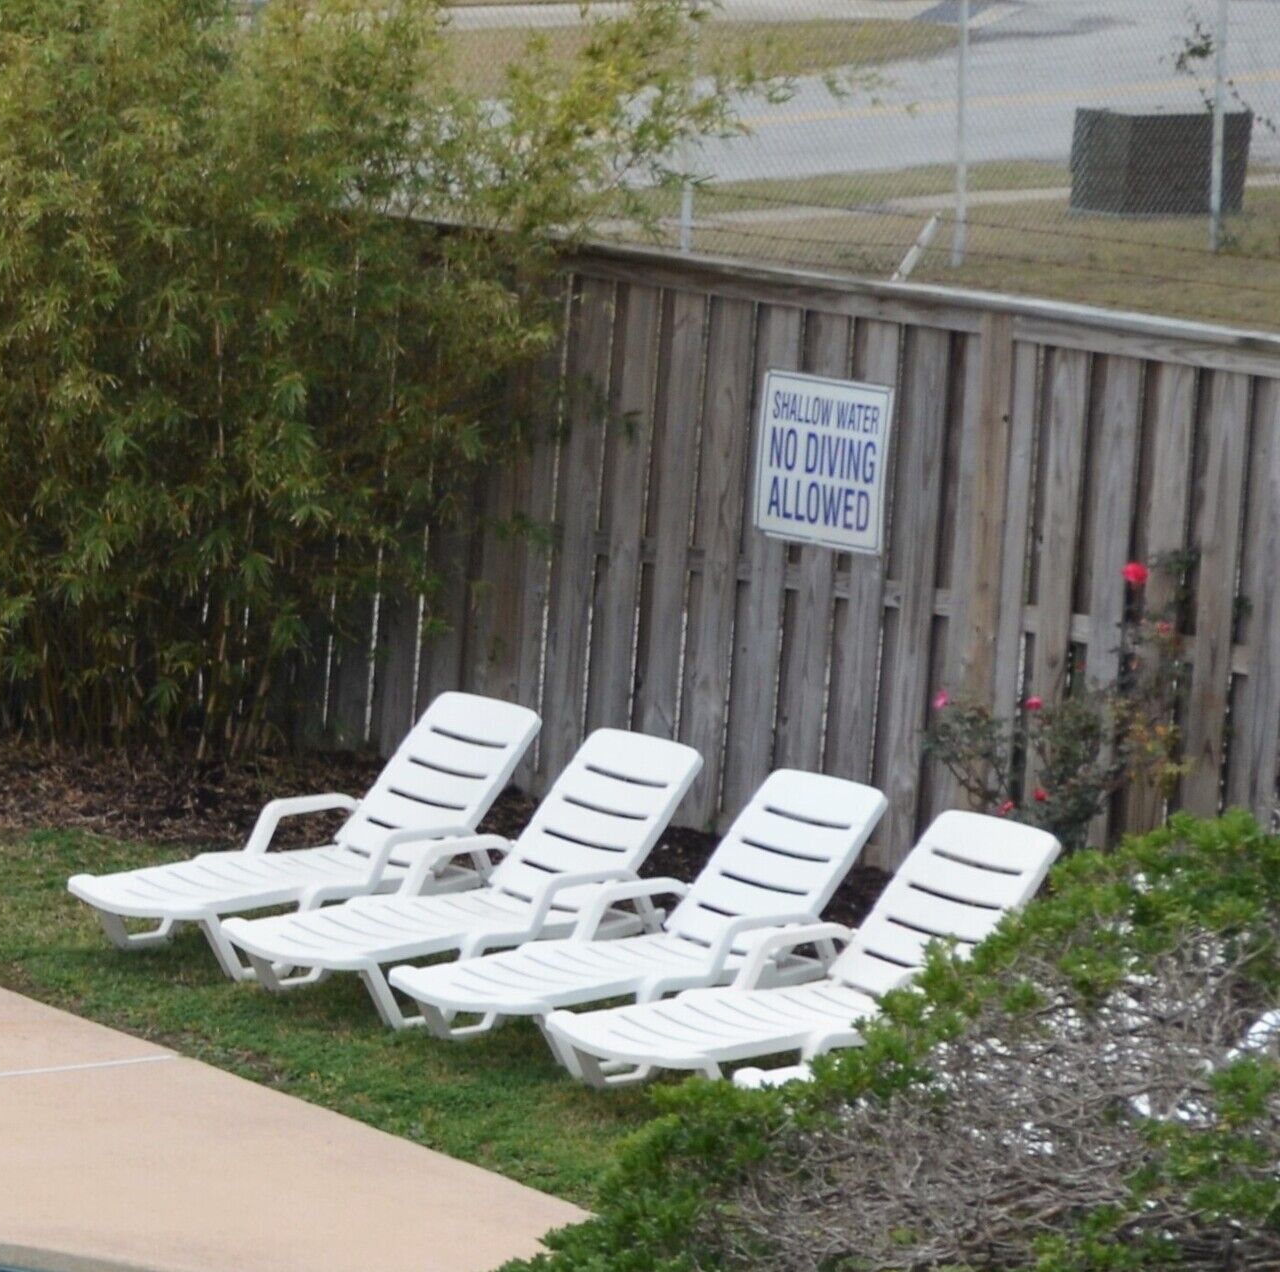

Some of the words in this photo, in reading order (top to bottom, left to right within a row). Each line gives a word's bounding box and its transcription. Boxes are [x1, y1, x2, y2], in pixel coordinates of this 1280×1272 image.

[773, 390, 833, 426] SHALLOW
[837, 401, 880, 435] WATER
[769, 426, 798, 471] NO
[804, 433, 876, 484] DIVING
[767, 475, 870, 532] ALLOWED
